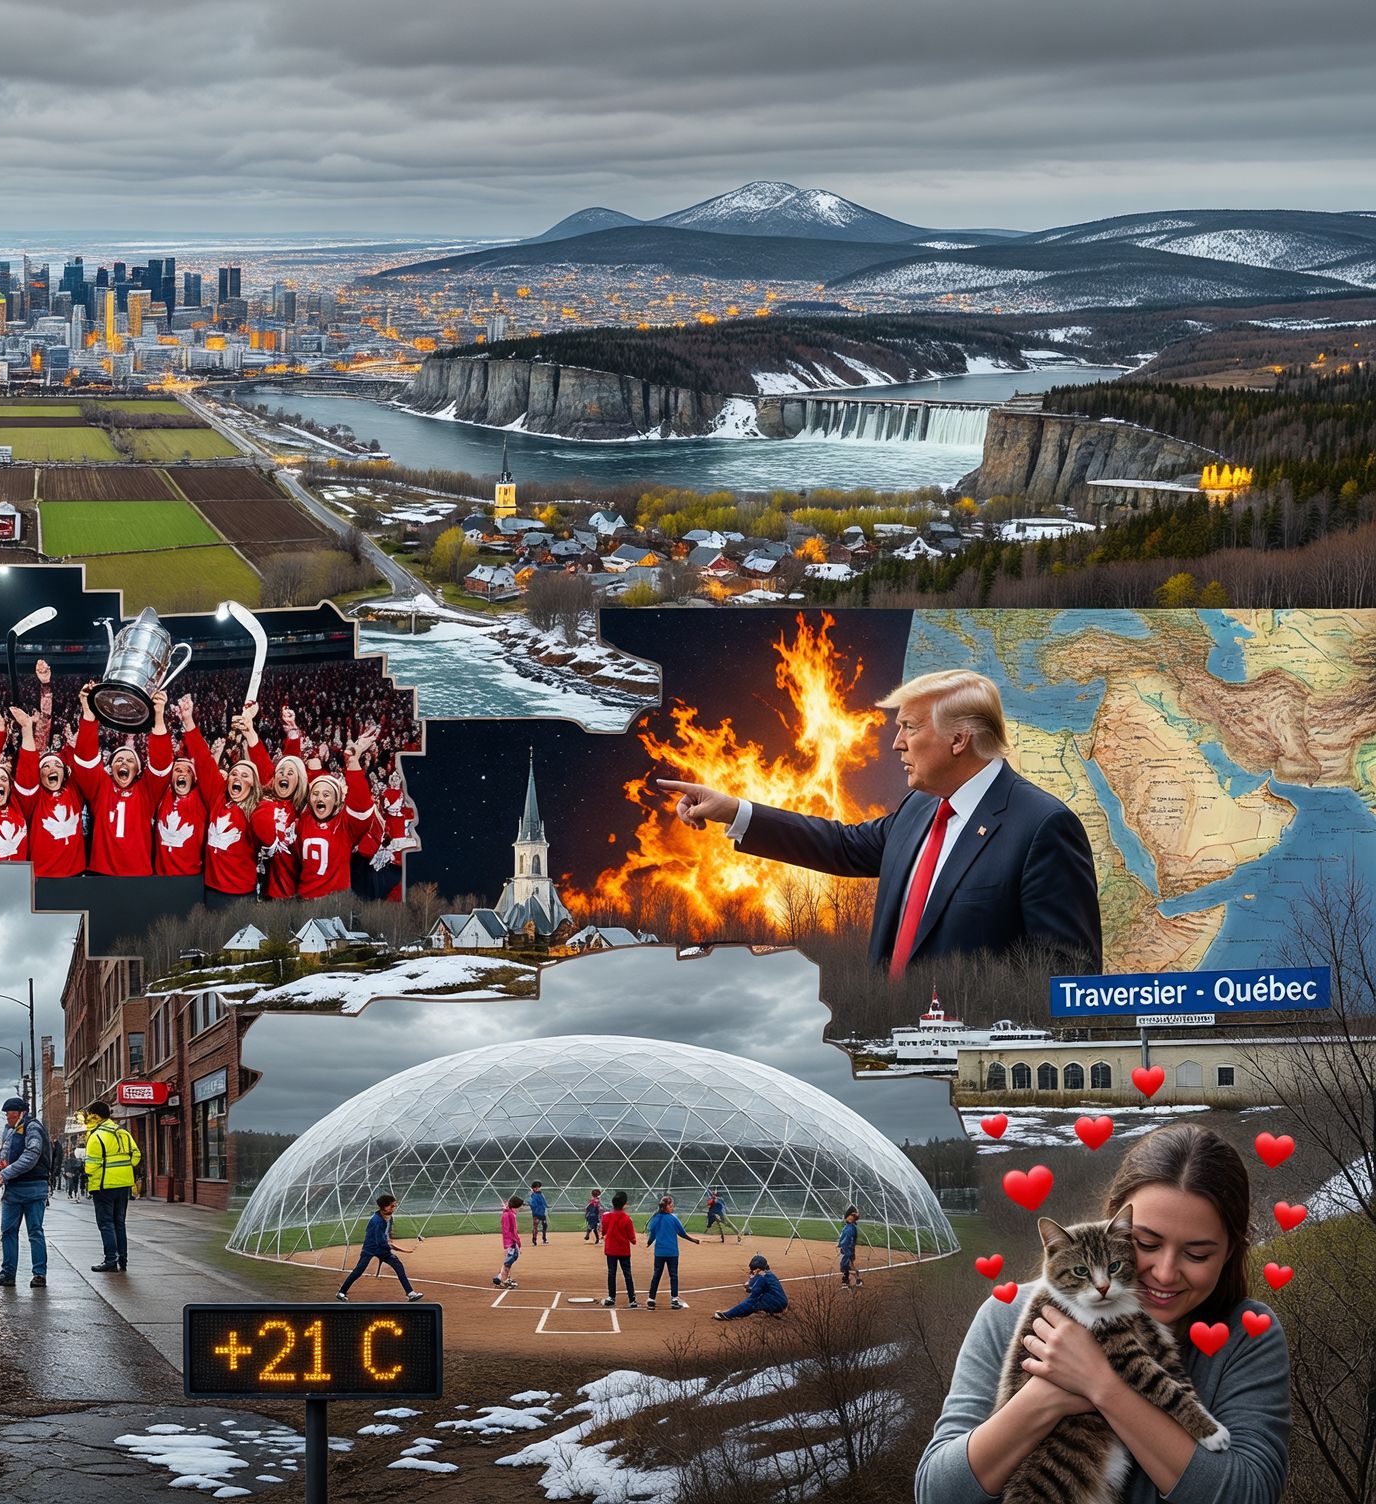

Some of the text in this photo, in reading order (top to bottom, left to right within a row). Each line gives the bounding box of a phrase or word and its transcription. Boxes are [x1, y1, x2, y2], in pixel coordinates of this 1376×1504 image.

[1059, 979, 1187, 1008] Traversier
[1214, 975, 1317, 1006] Québec
[214, 1320, 403, 1381] +21 C
